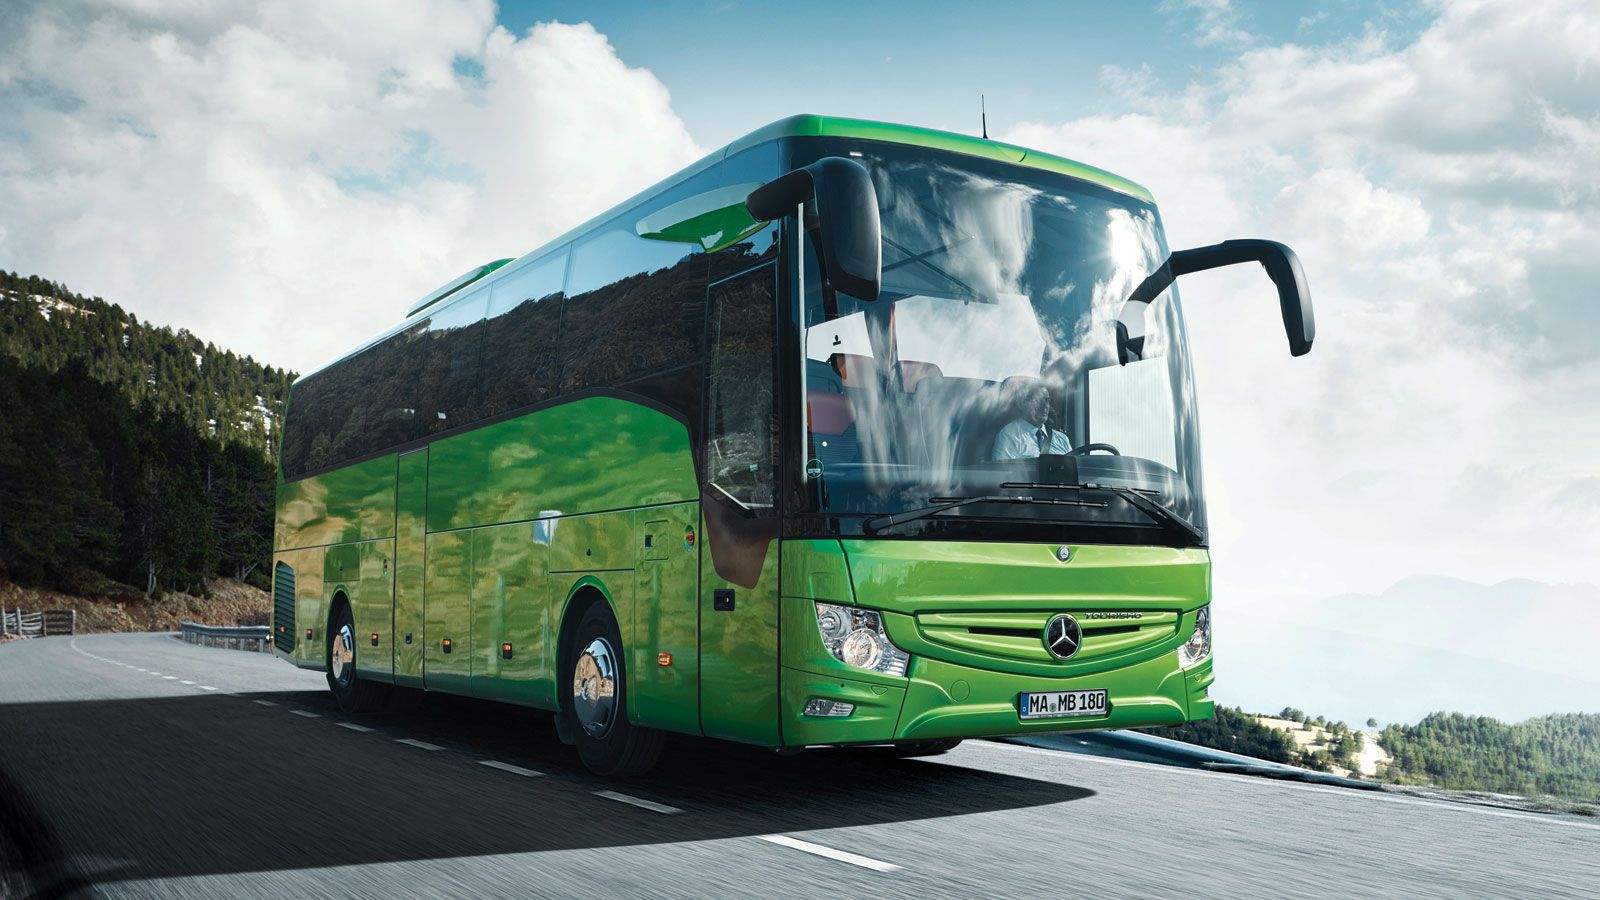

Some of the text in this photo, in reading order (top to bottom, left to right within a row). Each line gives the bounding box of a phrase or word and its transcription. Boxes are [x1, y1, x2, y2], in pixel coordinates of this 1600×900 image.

[1030, 693, 1104, 713] MA MB 180
